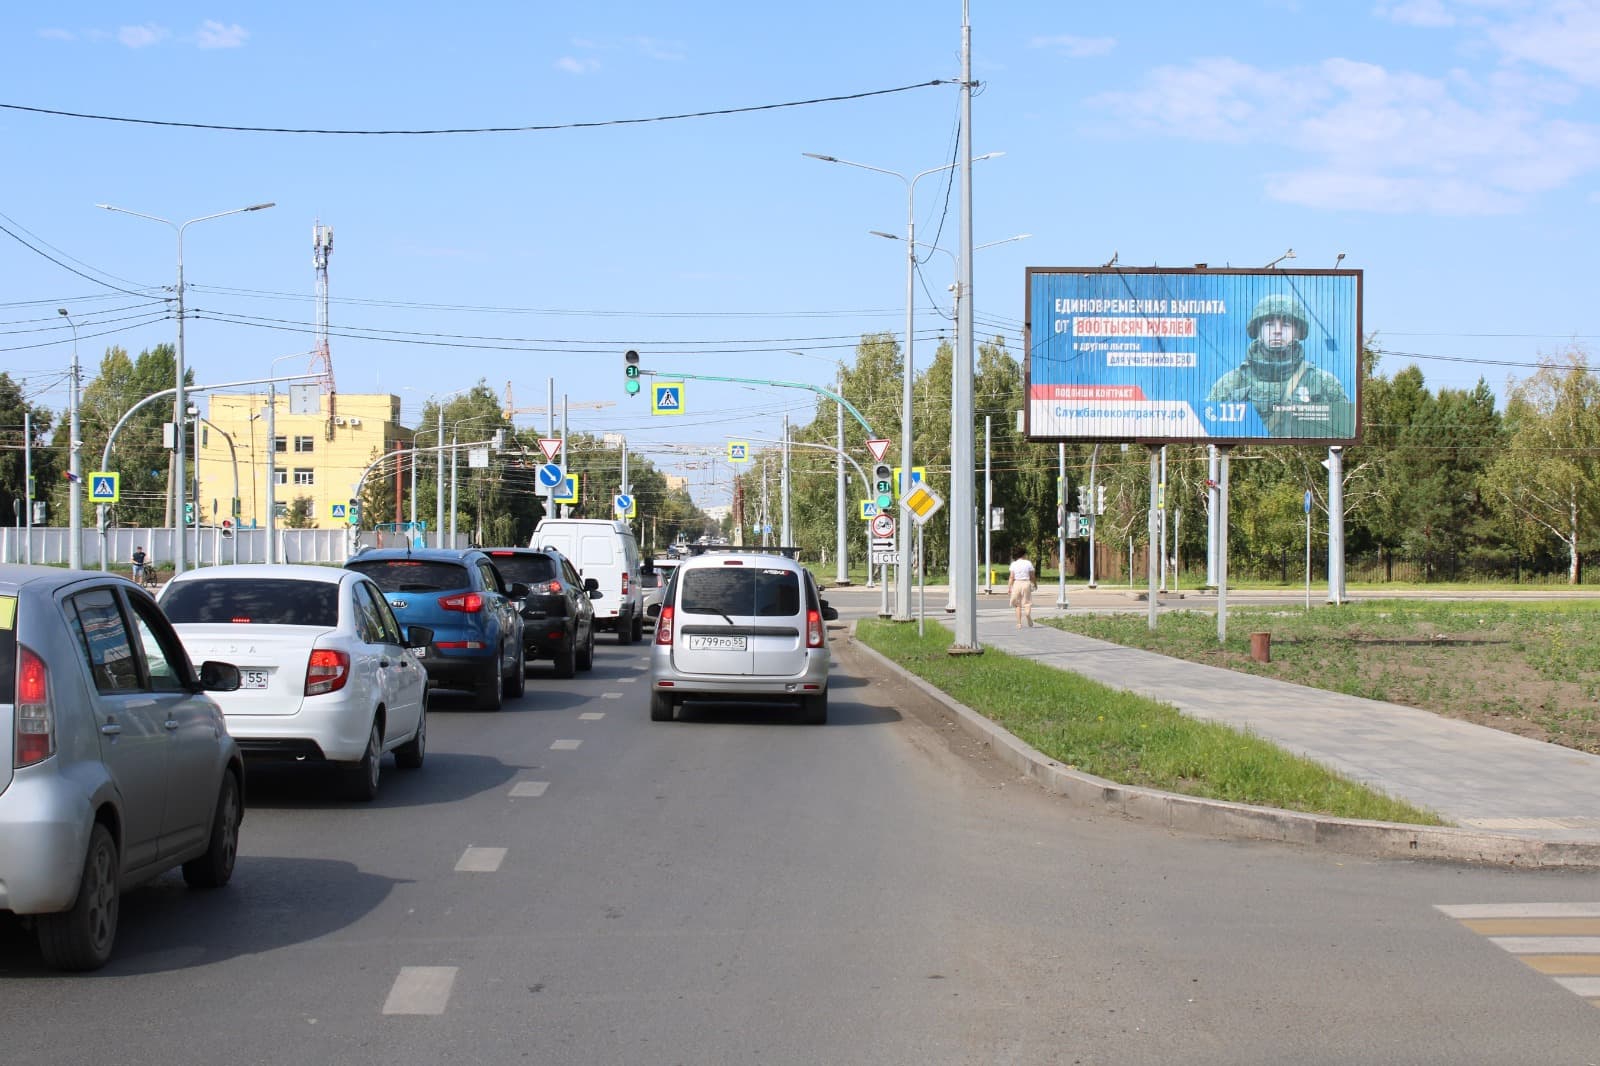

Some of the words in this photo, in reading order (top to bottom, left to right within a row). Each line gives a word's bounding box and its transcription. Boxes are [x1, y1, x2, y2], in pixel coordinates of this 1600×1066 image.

[1055, 298, 1168, 314] ЕДИНОВРЕМЕННАЯ
[1170, 299, 1226, 315] ВЫПЛАТА
[1054, 319, 1070, 334] ОТ
[1076, 320, 1100, 334] 800
[1103, 320, 1143, 335] ТЫСЯЧ
[1146, 318, 1193, 335] РУБЛЕЙ
[1127, 355, 1174, 366] участников
[627, 367, 638, 377] 31
[1095, 388, 1133, 399] КОНТРАКТ
[1219, 403, 1246, 422] 117
